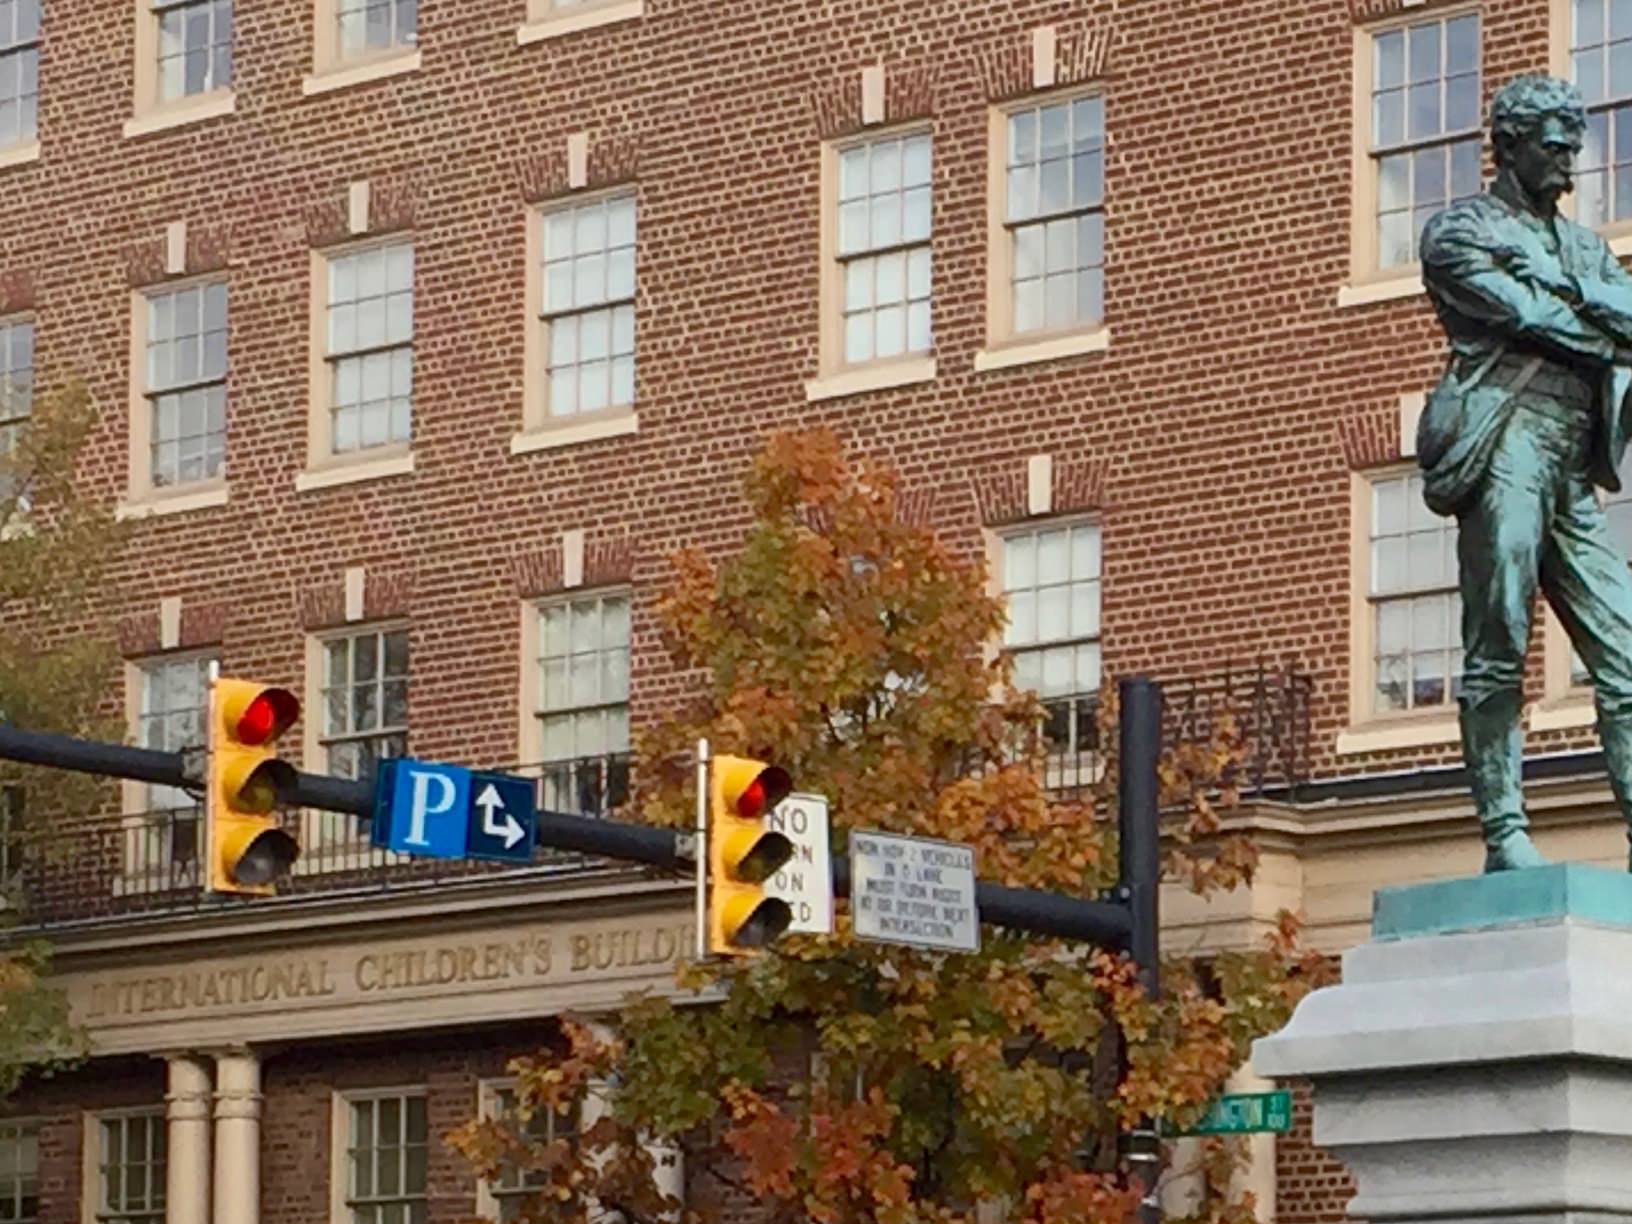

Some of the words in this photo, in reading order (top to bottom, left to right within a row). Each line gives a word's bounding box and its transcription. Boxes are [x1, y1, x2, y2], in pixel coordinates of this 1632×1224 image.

[403, 769, 457, 846] P
[769, 806, 808, 834] NO
[775, 871, 804, 892] ON
[866, 878, 896, 895] MUST
[900, 882, 927, 899] TURN
[943, 906, 970, 922] NEXT
[85, 958, 335, 1018] INTERNATIONAL
[354, 936, 553, 993] CHILDREN'S
[570, 924, 696, 970] BUILDI
